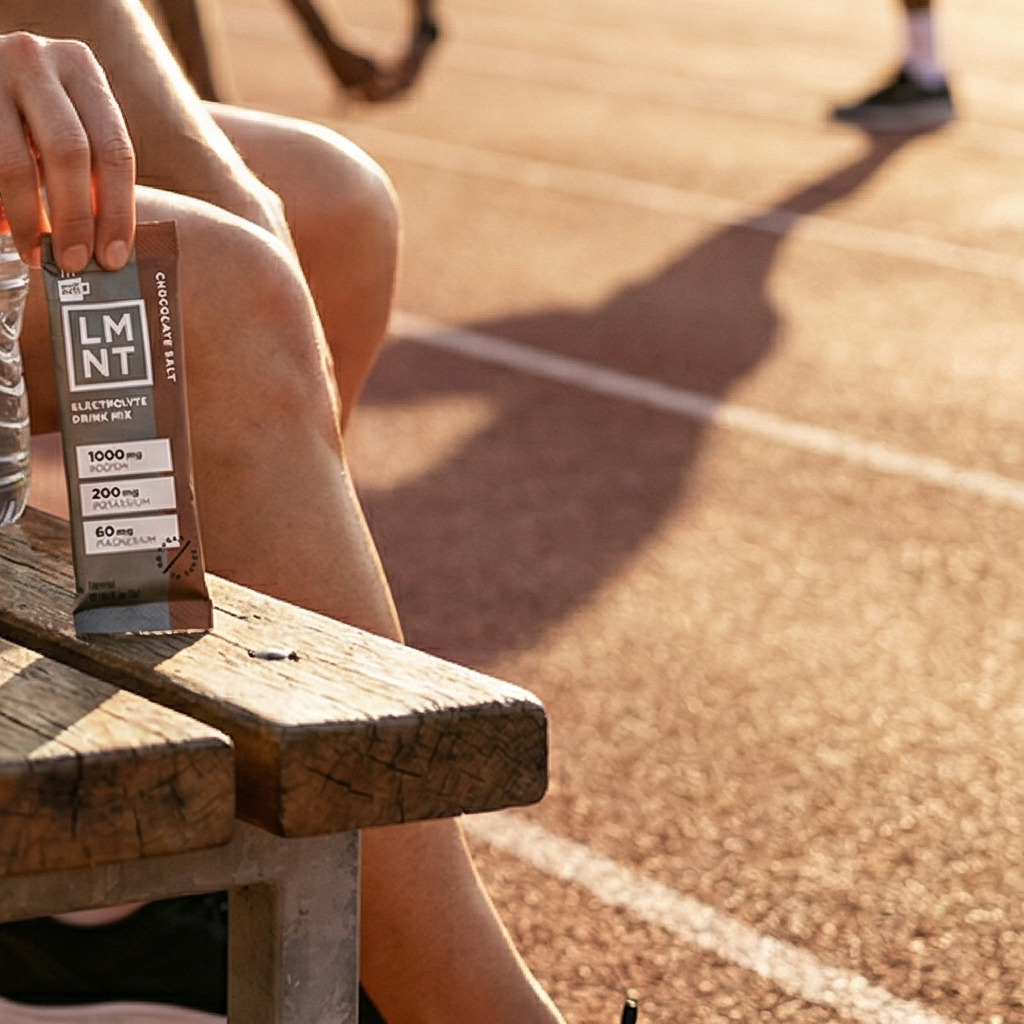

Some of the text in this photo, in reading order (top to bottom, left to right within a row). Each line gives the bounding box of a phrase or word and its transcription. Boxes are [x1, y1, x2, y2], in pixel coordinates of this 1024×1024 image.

[88, 449, 125, 462] 1000
[92, 487, 121, 499] 200
[95, 525, 115, 538] 60
